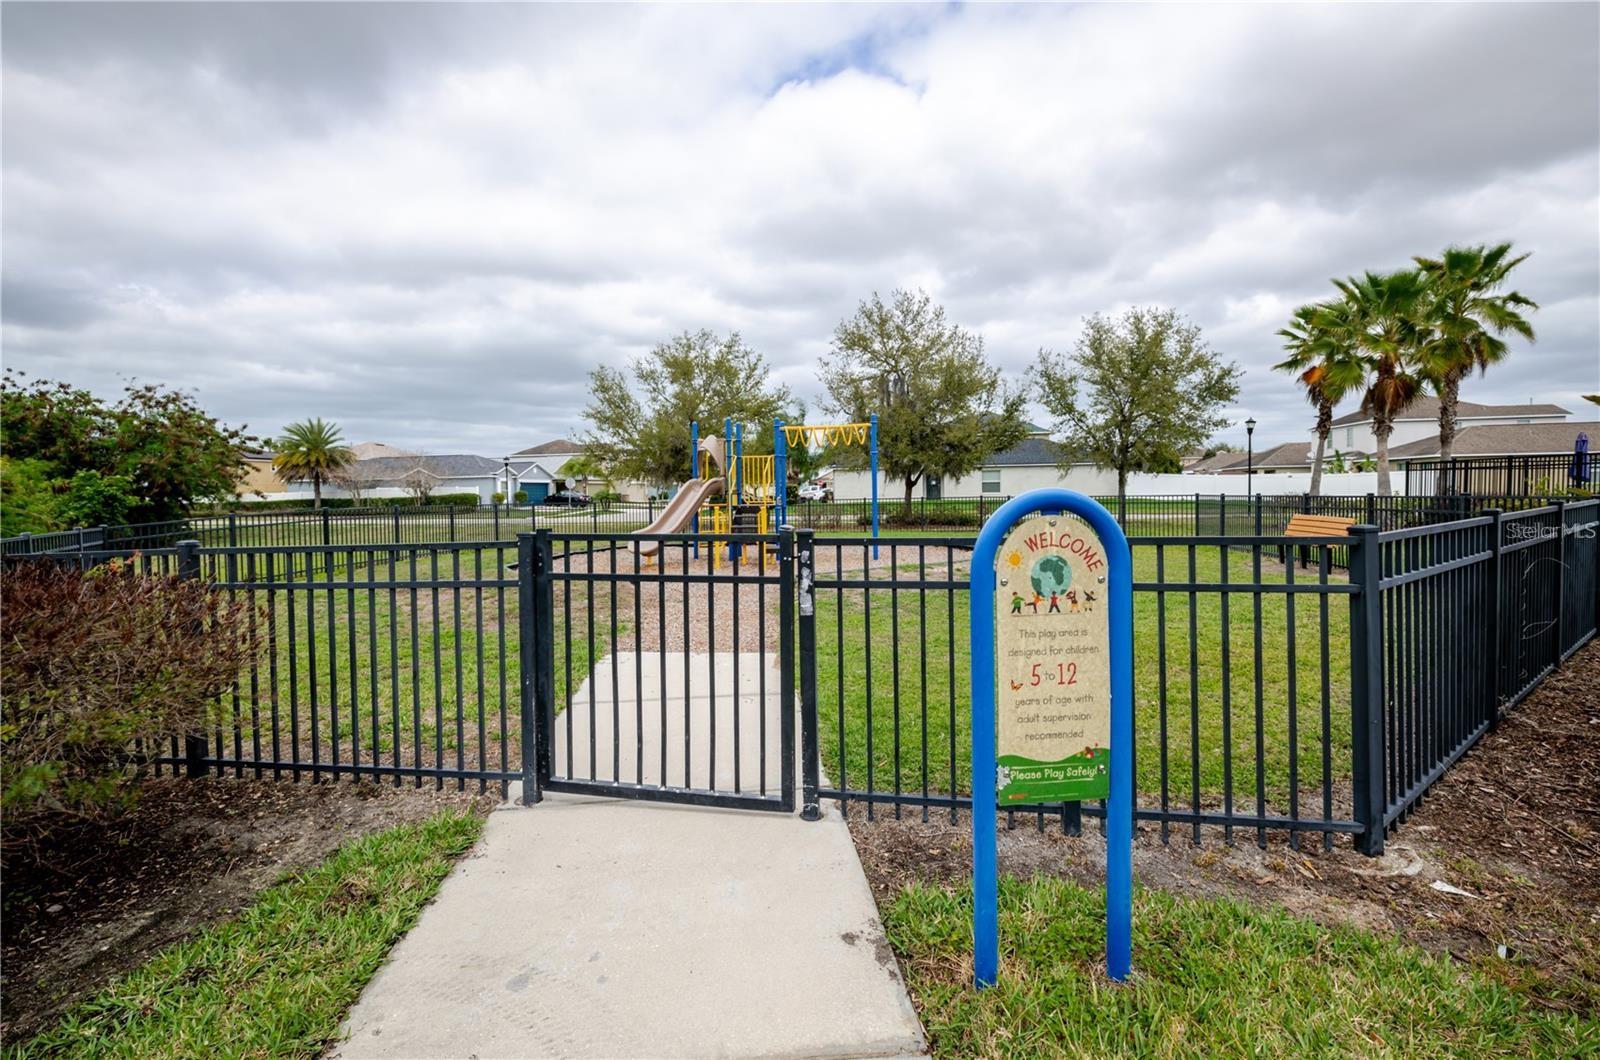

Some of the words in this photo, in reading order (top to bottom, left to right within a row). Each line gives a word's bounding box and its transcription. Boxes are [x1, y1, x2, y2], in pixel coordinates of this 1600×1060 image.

[1024, 531, 1104, 573] WELCOME
[1019, 629, 1036, 639] This
[1039, 628, 1056, 640] play
[1058, 629, 1079, 637] area
[1008, 647, 1047, 659] designed
[1049, 645, 1063, 656] for
[1065, 645, 1099, 655] children
[1030, 663, 1041, 686] 5
[1044, 672, 1055, 681] to
[1057, 662, 1077, 685] 12
[1015, 698, 1040, 709] years
[1042, 694, 1053, 705] of
[1055, 697, 1072, 707] age
[1074, 694, 1094, 703] with
[1017, 713, 1040, 723] adult
[1042, 713, 1092, 724] supervision
[1024, 730, 1084, 741] recommended
[1010, 770, 1041, 780] Please
[1044, 768, 1064, 780] Play
[1066, 765, 1098, 777] Safely!
